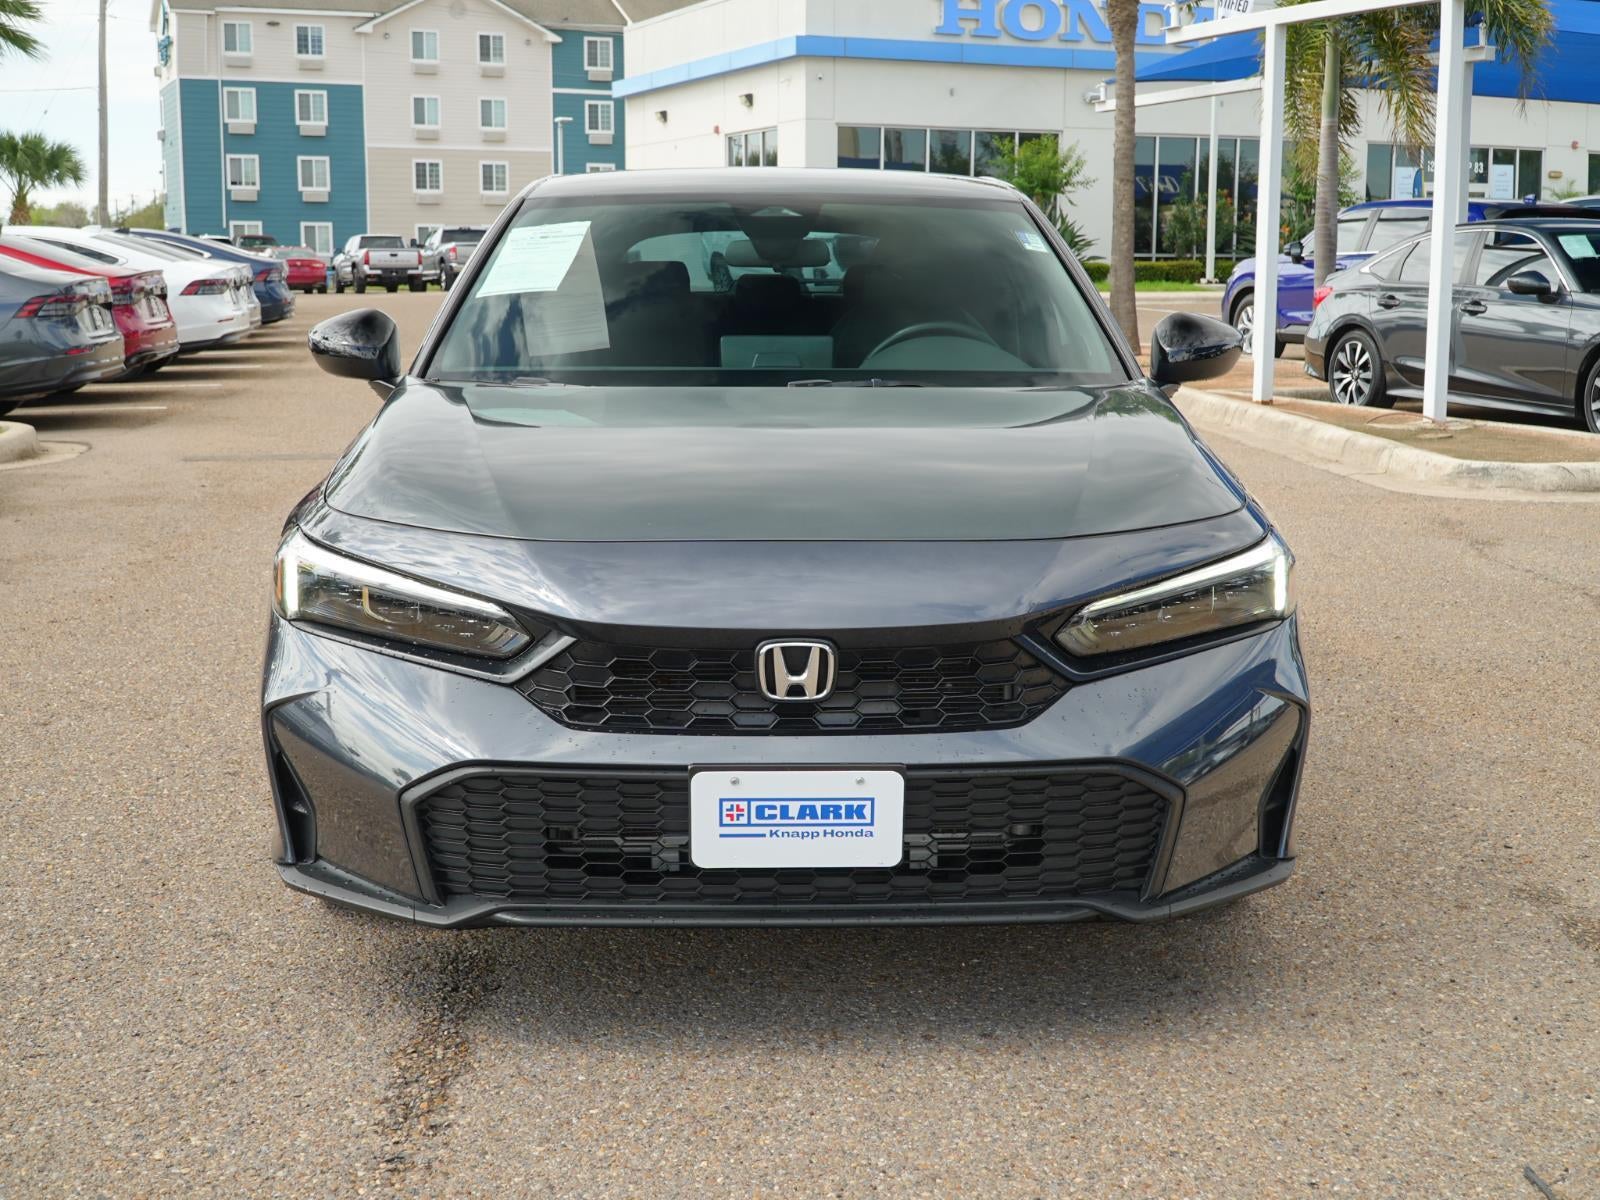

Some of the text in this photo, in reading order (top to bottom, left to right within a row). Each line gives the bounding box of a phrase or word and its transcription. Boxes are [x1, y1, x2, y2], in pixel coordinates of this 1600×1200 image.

[1474, 161, 1484, 174] 83
[755, 804, 867, 821] CLARK
[769, 829, 874, 840] Knapp Honda
